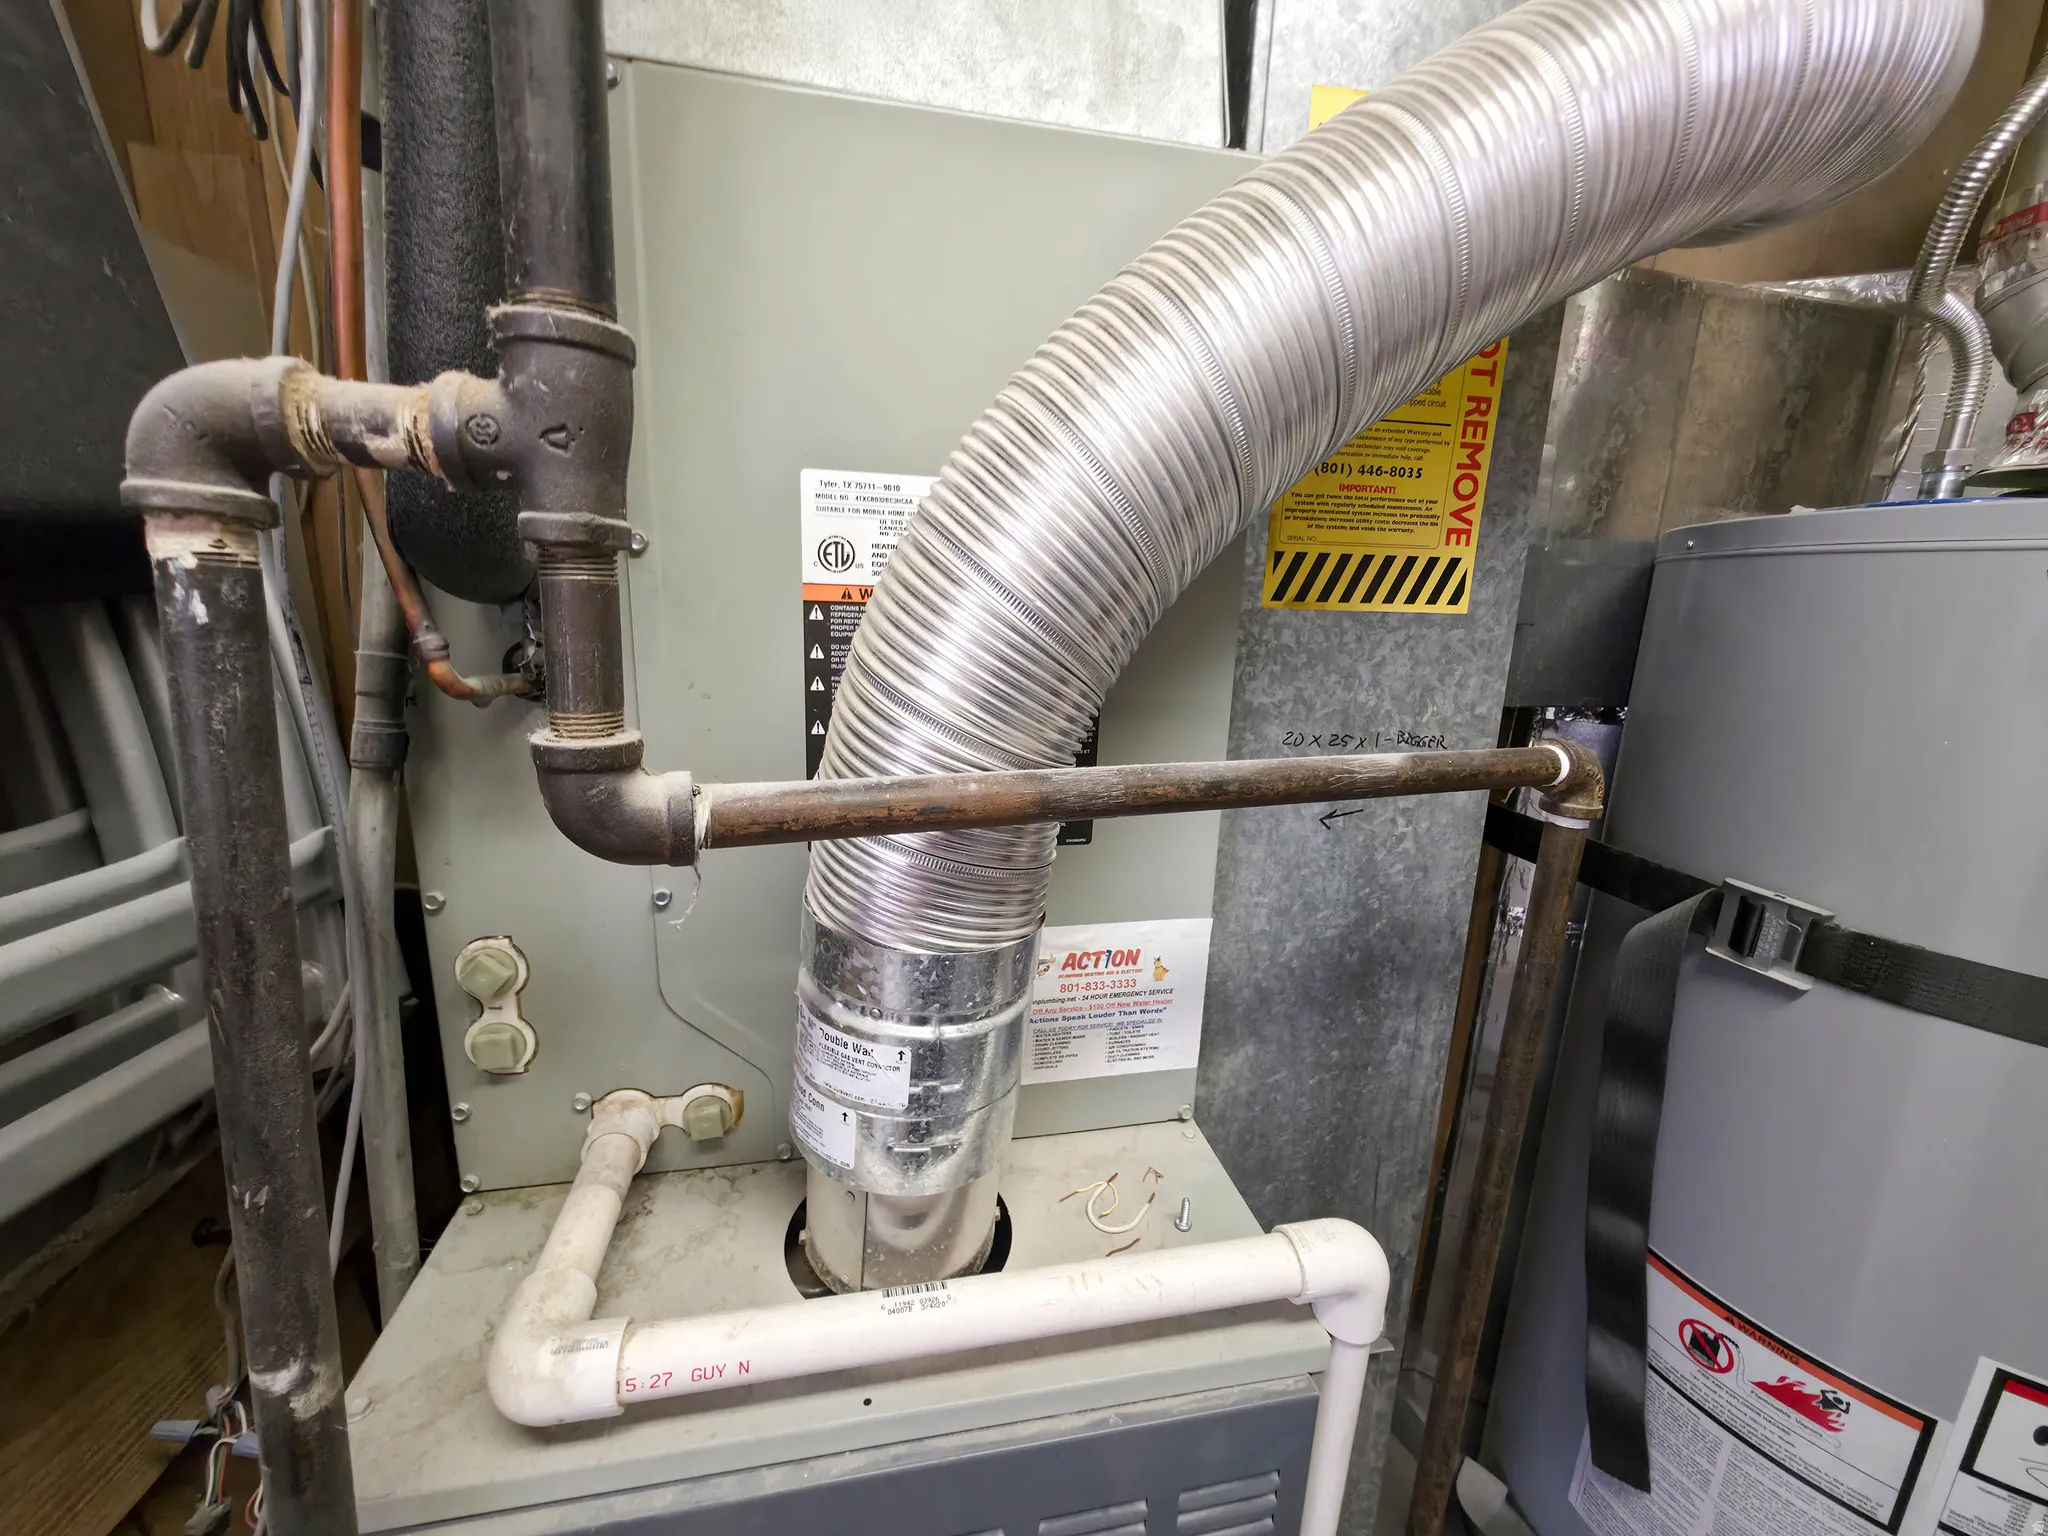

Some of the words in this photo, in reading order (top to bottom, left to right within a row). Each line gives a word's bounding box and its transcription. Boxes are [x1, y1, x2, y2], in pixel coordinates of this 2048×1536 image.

[1427, 399, 1447, 409] circuit
[1407, 429, 1432, 438] Warranty
[1404, 437, 1415, 445] type
[1416, 438, 1443, 447] performed
[1444, 440, 1451, 448] by
[1315, 463, 1353, 478] (801)
[1358, 464, 1424, 479] 446-8035
[1445, 396, 1492, 547] REMOVE
[819, 480, 841, 489] Tyler,
[842, 481, 853, 490] TX
[1338, 483, 1397, 495] IMPORTANT!
[815, 505, 845, 513] SUITABLE
[847, 507, 861, 515] FOR
[862, 508, 886, 517] MOBILE
[1284, 507, 1317, 515] improperly
[871, 543, 899, 551] HEATIN
[821, 540, 851, 570] ETL
[1281, 731, 1305, 747] 20
[1328, 733, 1354, 747] 25
[1061, 948, 1142, 971] ACTION
[1058, 972, 1083, 980] PLUMBING
[1059, 978, 1137, 994] 801-833-3333
[1090, 992, 1108, 1001] HOUR
[1109, 990, 1147, 999] EMERGENCY
[1148, 988, 1175, 996] SERVICE
[1044, 1007, 1057, 1015] Any
[1058, 1005, 1083, 1013] Service
[1132, 999, 1151, 1007] Water
[1152, 998, 1173, 1006] Heater
[1029, 1016, 1061, 1024] Actions
[1062, 1013, 1087, 1023] Speak
[1088, 1011, 1115, 1020] Louder
[1126, 1018, 1156, 1026] SPECIALIZE
[818, 1041, 840, 1056] FLEXIBLE
[841, 1051, 851, 1061] GAS
[851, 1056, 865, 1066] VENT
[867, 1061, 901, 1072] CONNCTOR
[880, 1303, 886, 1311] 6
[894, 1300, 915, 1308] 11942
[919, 1296, 940, 1304] 03926
[1738, 1322, 1800, 1366] WARNING
[691, 1363, 728, 1382] GUY
[738, 1360, 752, 1374] N
